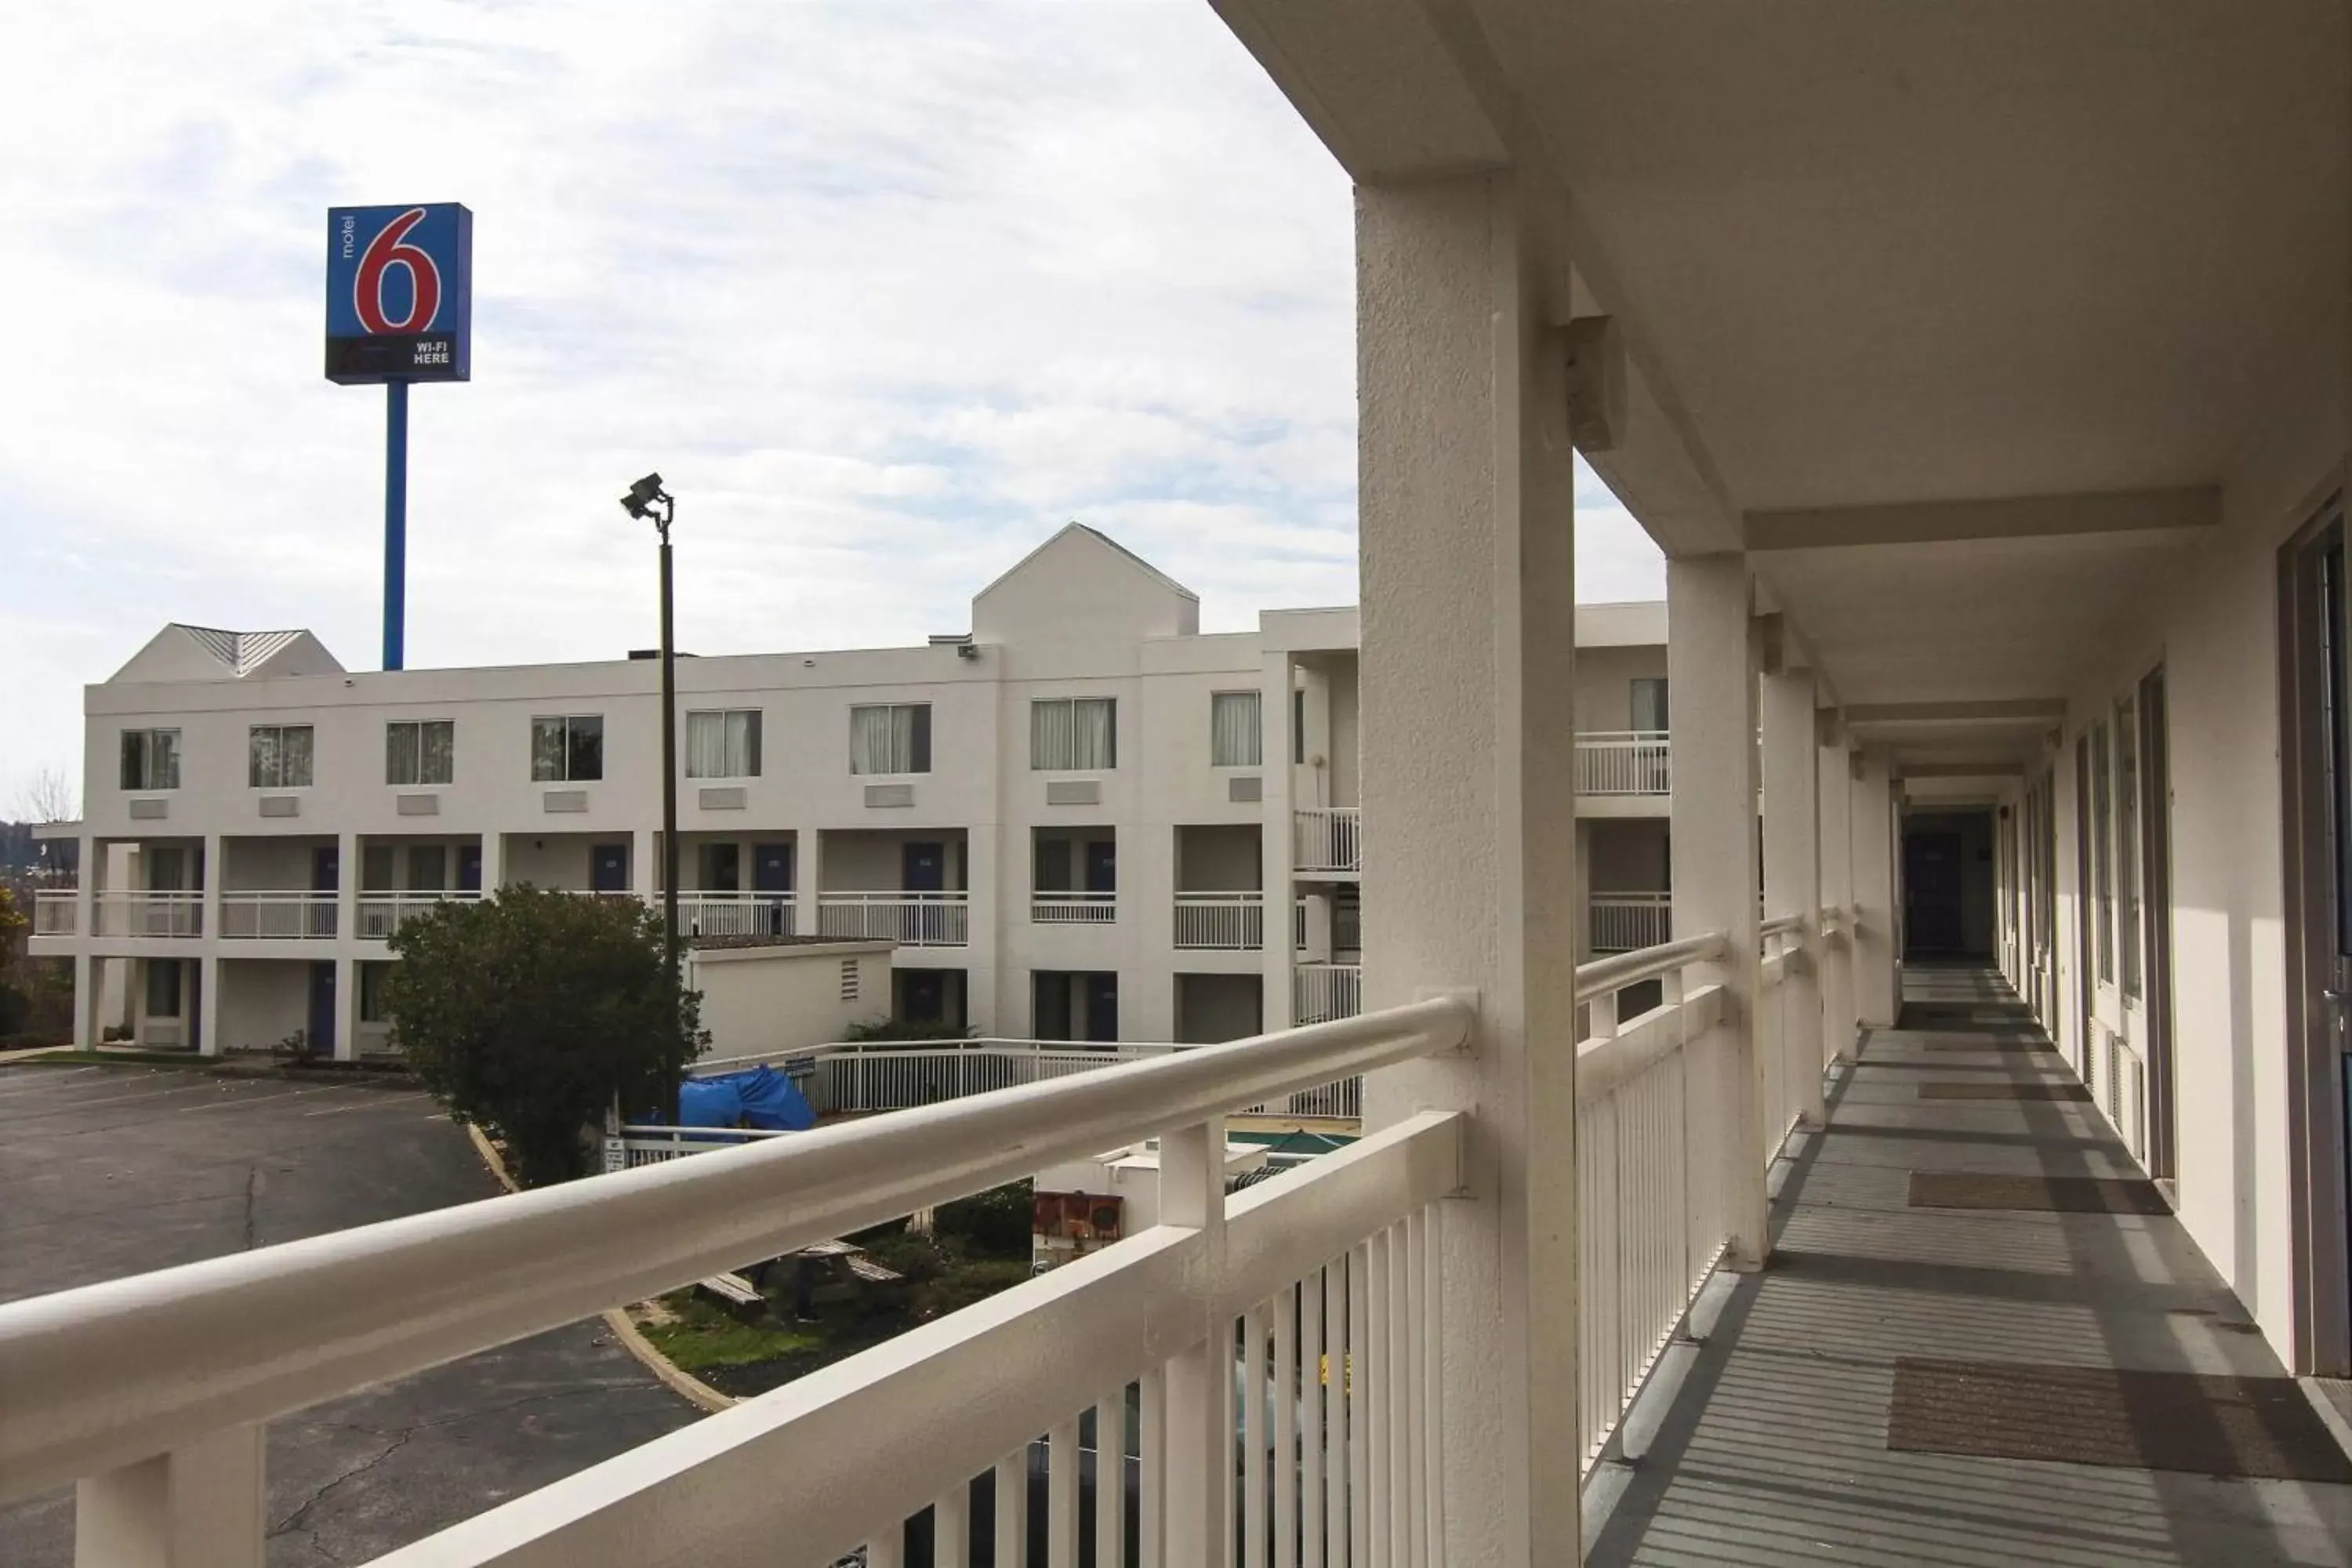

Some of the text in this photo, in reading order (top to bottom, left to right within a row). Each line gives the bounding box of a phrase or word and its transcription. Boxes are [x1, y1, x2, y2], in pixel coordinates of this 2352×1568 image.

[342, 216, 354, 258] motel
[354, 208, 441, 334] 6
[414, 353, 449, 365] HERE
[416, 341, 447, 352] WI-FI
